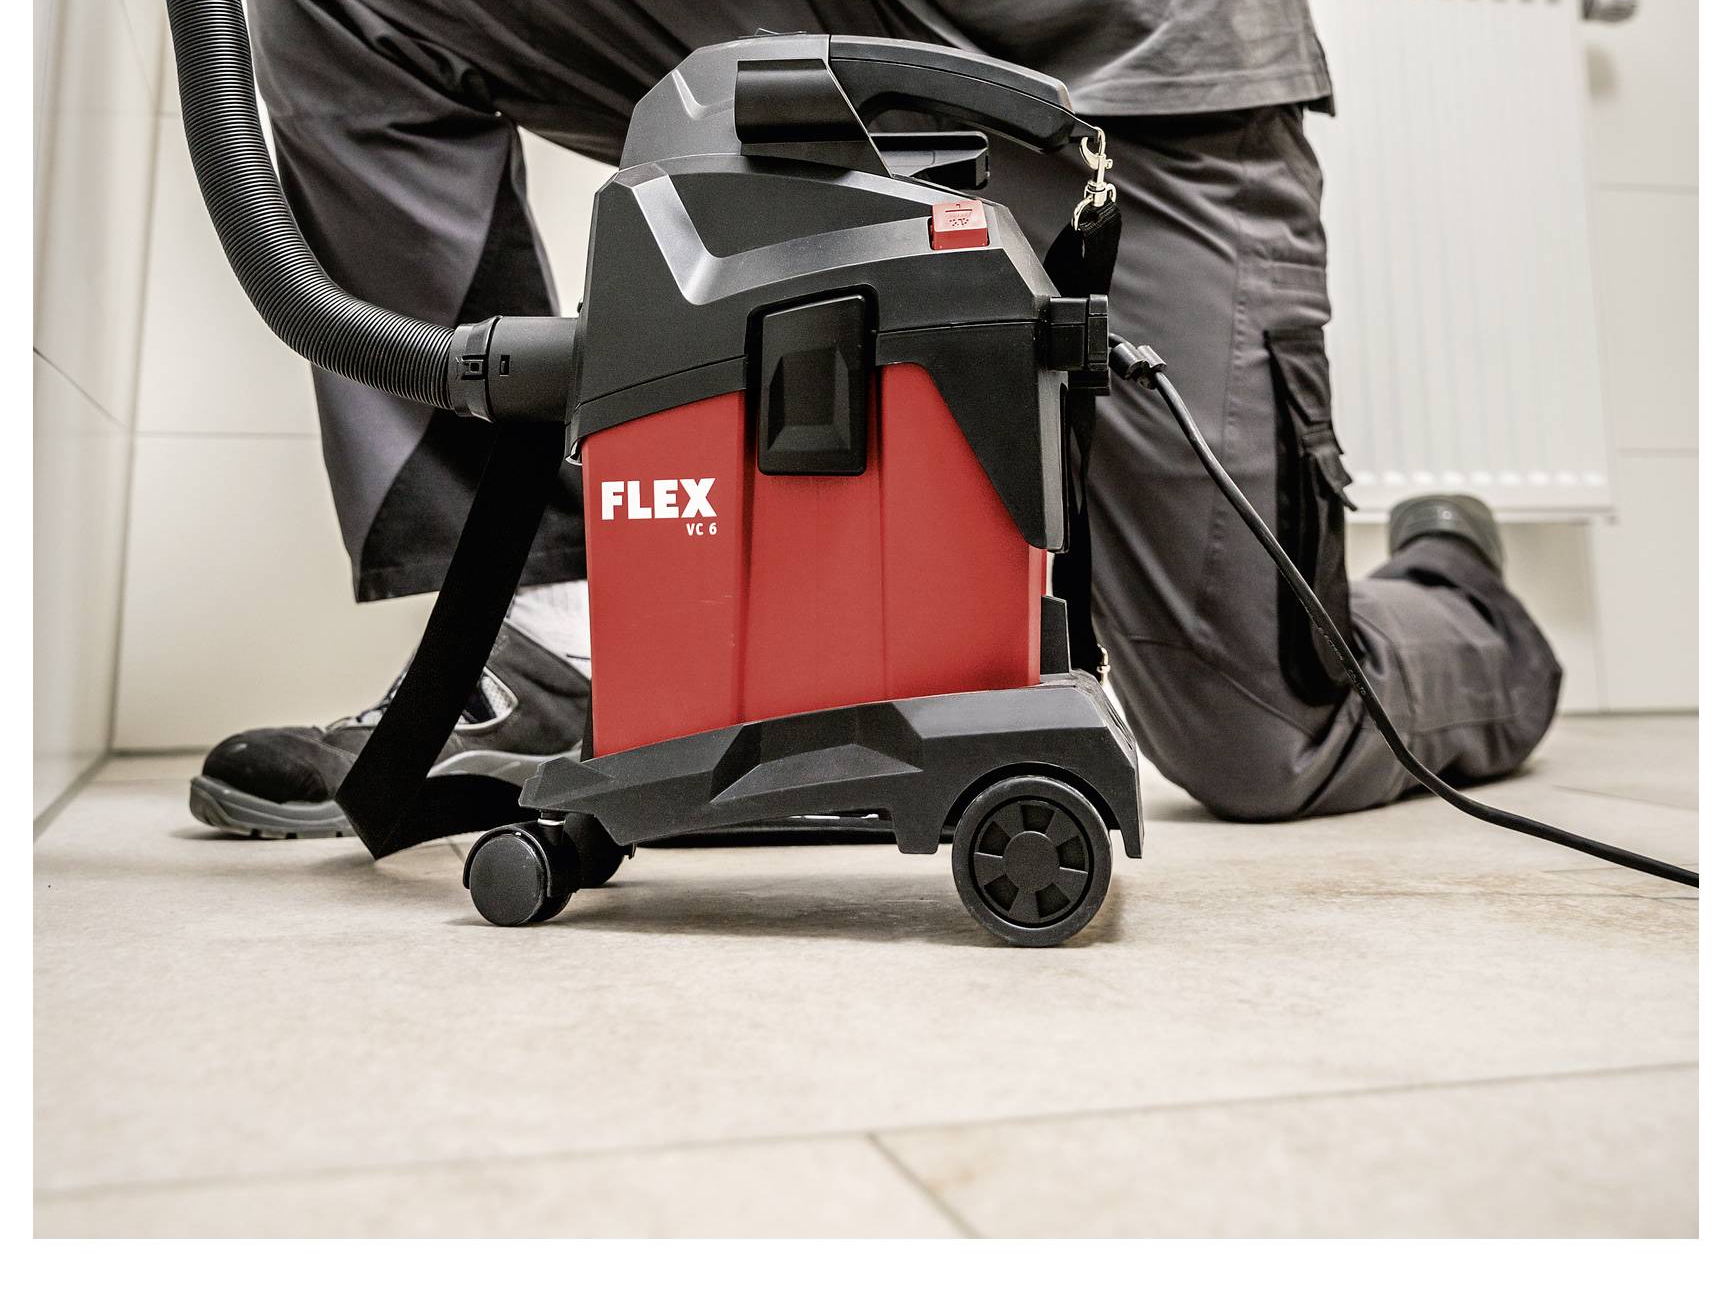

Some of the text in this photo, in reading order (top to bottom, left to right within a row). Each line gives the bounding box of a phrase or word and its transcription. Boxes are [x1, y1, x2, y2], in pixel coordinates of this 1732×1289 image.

[601, 477, 718, 521] FLEX
[685, 521, 718, 536] VC 6
